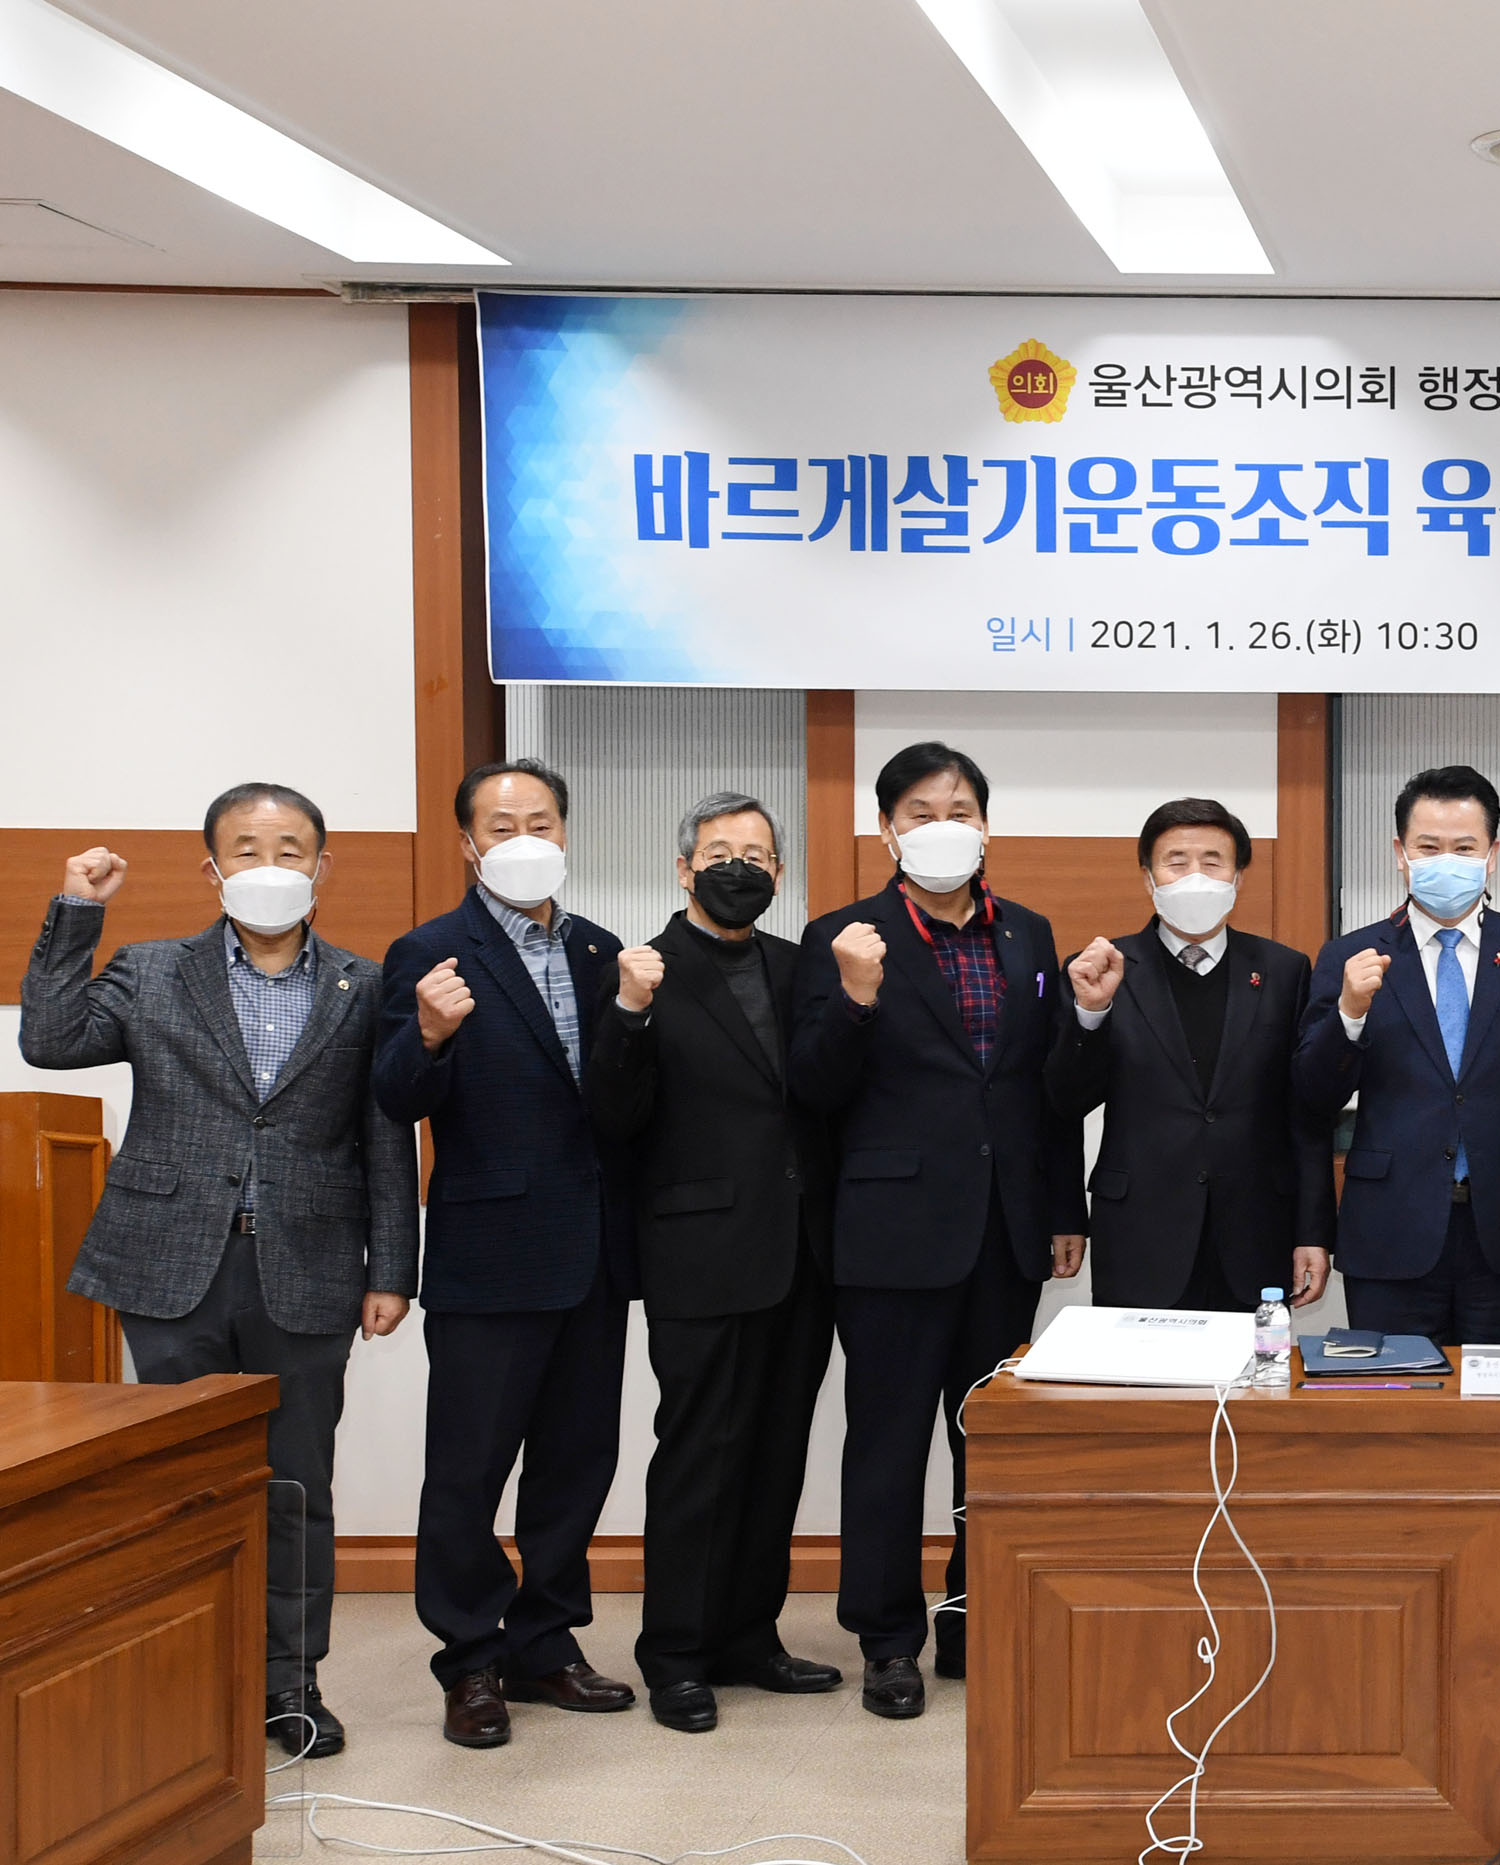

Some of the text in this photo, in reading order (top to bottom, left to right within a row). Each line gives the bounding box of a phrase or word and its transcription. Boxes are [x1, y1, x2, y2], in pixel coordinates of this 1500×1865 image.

[1010, 372, 1054, 394] 의회
[1087, 362, 1397, 411] 울산광역시의회
[633, 450, 1390, 556] 바르게살기운동조직
[986, 616, 1051, 653] 일시
[1089, 619, 1191, 652] 2021.
[1206, 620, 1235, 652] 1.
[1376, 620, 1479, 652] 10:30
